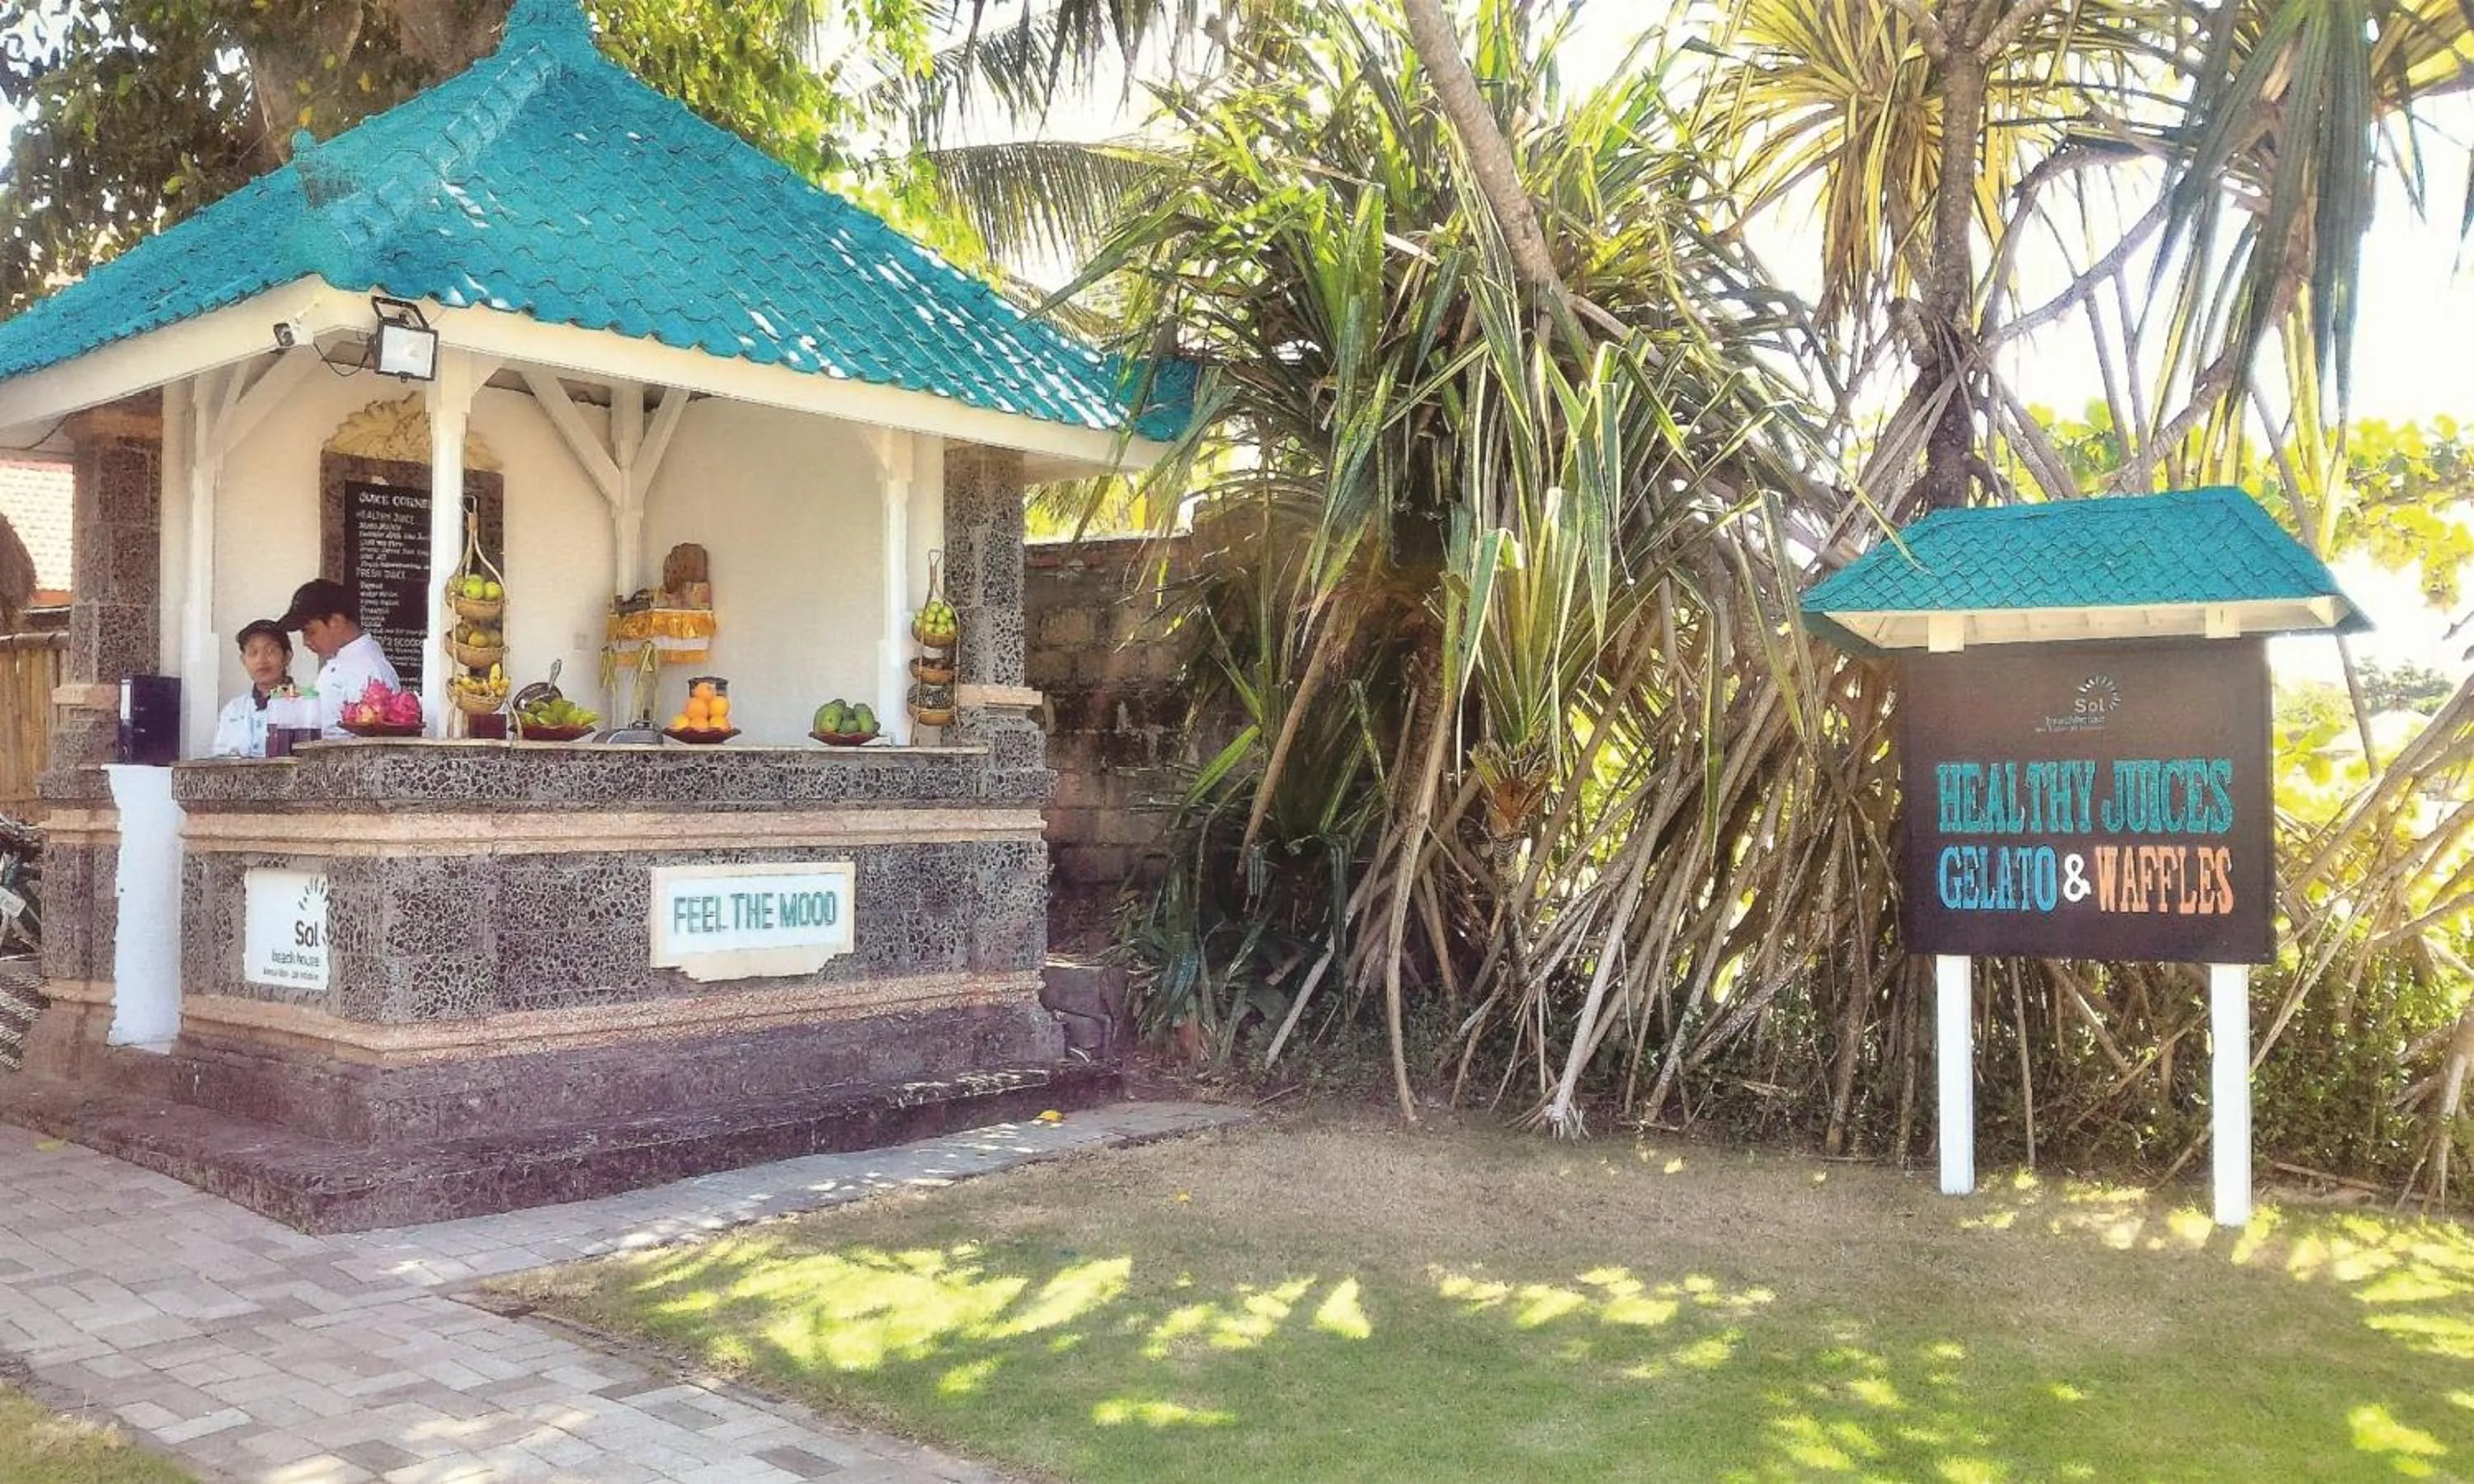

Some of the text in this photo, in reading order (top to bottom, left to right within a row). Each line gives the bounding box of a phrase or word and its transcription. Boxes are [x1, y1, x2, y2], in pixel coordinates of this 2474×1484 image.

[393, 495, 432, 509] CORNE
[2074, 697, 2105, 714] Sol
[1935, 757, 2234, 834] HEALTHY JUICES
[1938, 843, 2235, 914] GELATO & WAFFLES
[674, 891, 837, 934] FEEL THE MOOD
[295, 919, 320, 947] Sol
